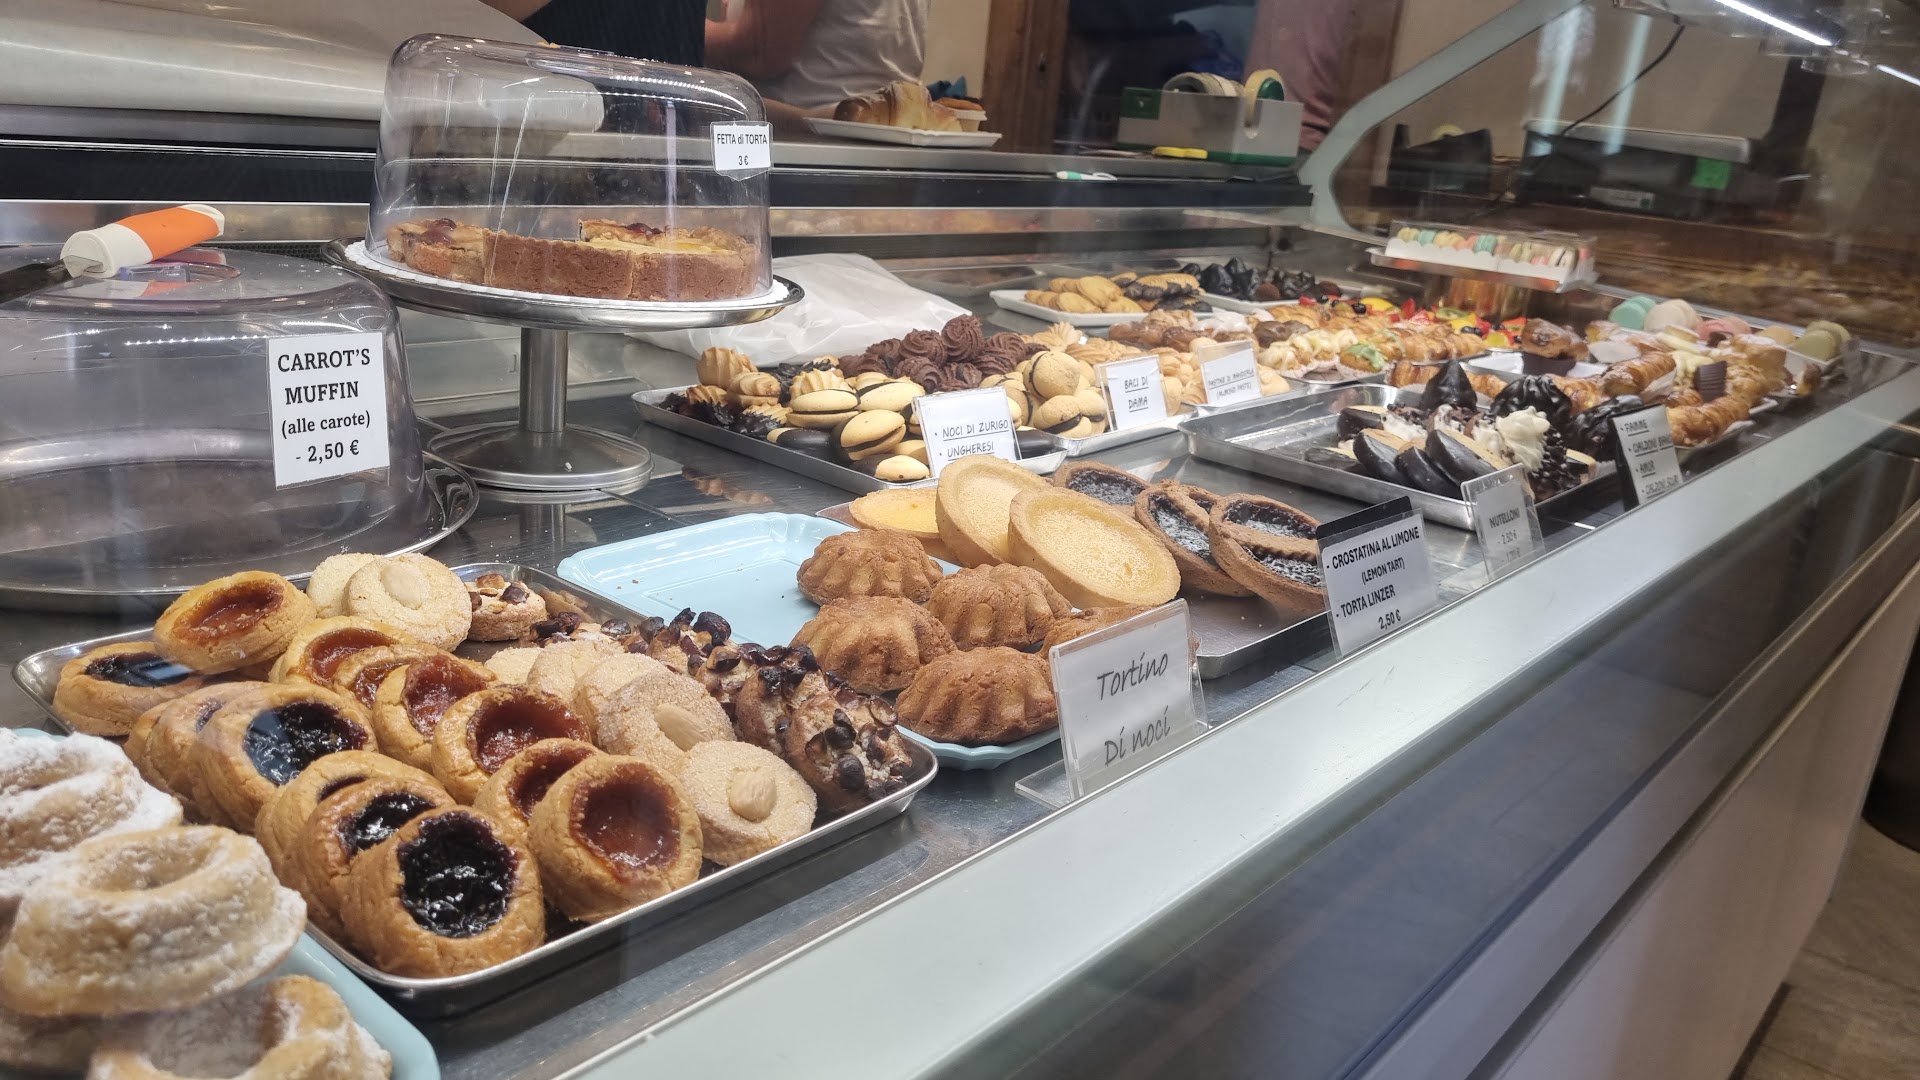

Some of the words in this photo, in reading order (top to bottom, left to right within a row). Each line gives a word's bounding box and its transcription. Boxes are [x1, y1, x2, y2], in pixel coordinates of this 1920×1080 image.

[716, 133, 736, 145] FETTA
[737, 133, 744, 145] di
[745, 133, 768, 145] TORTA
[738, 155, 743, 166] 3
[744, 155, 749, 166] €
[277, 348, 371, 373] CARROT'S
[284, 381, 359, 405] MUFFIN
[1124, 377, 1139, 390] BACI
[1141, 375, 1149, 387] DI
[1128, 396, 1148, 409] DAMA
[281, 417, 316, 440] (alle
[320, 409, 371, 430] carote)
[942, 425, 963, 438] NOCI
[966, 424, 975, 435] DI
[978, 419, 1009, 433] ZURIGO
[307, 441, 344, 464] 2,50
[349, 439, 360, 455] €
[947, 441, 994, 458] UNGHERESI
[1332, 540, 1382, 569] CROSTATINA
[1381, 537, 1391, 550] AL
[1392, 526, 1420, 547] LIMONE
[1361, 563, 1387, 585] (LEMON
[1387, 557, 1405, 573] TART)
[1341, 596, 1367, 618] TORTA
[1367, 584, 1396, 607] LINZER
[1378, 611, 1395, 630] 2,50
[1395, 609, 1402, 622] €
[1096, 651, 1168, 700] Tortino
[1104, 726, 1126, 767] Di
[1132, 705, 1171, 753] noci
